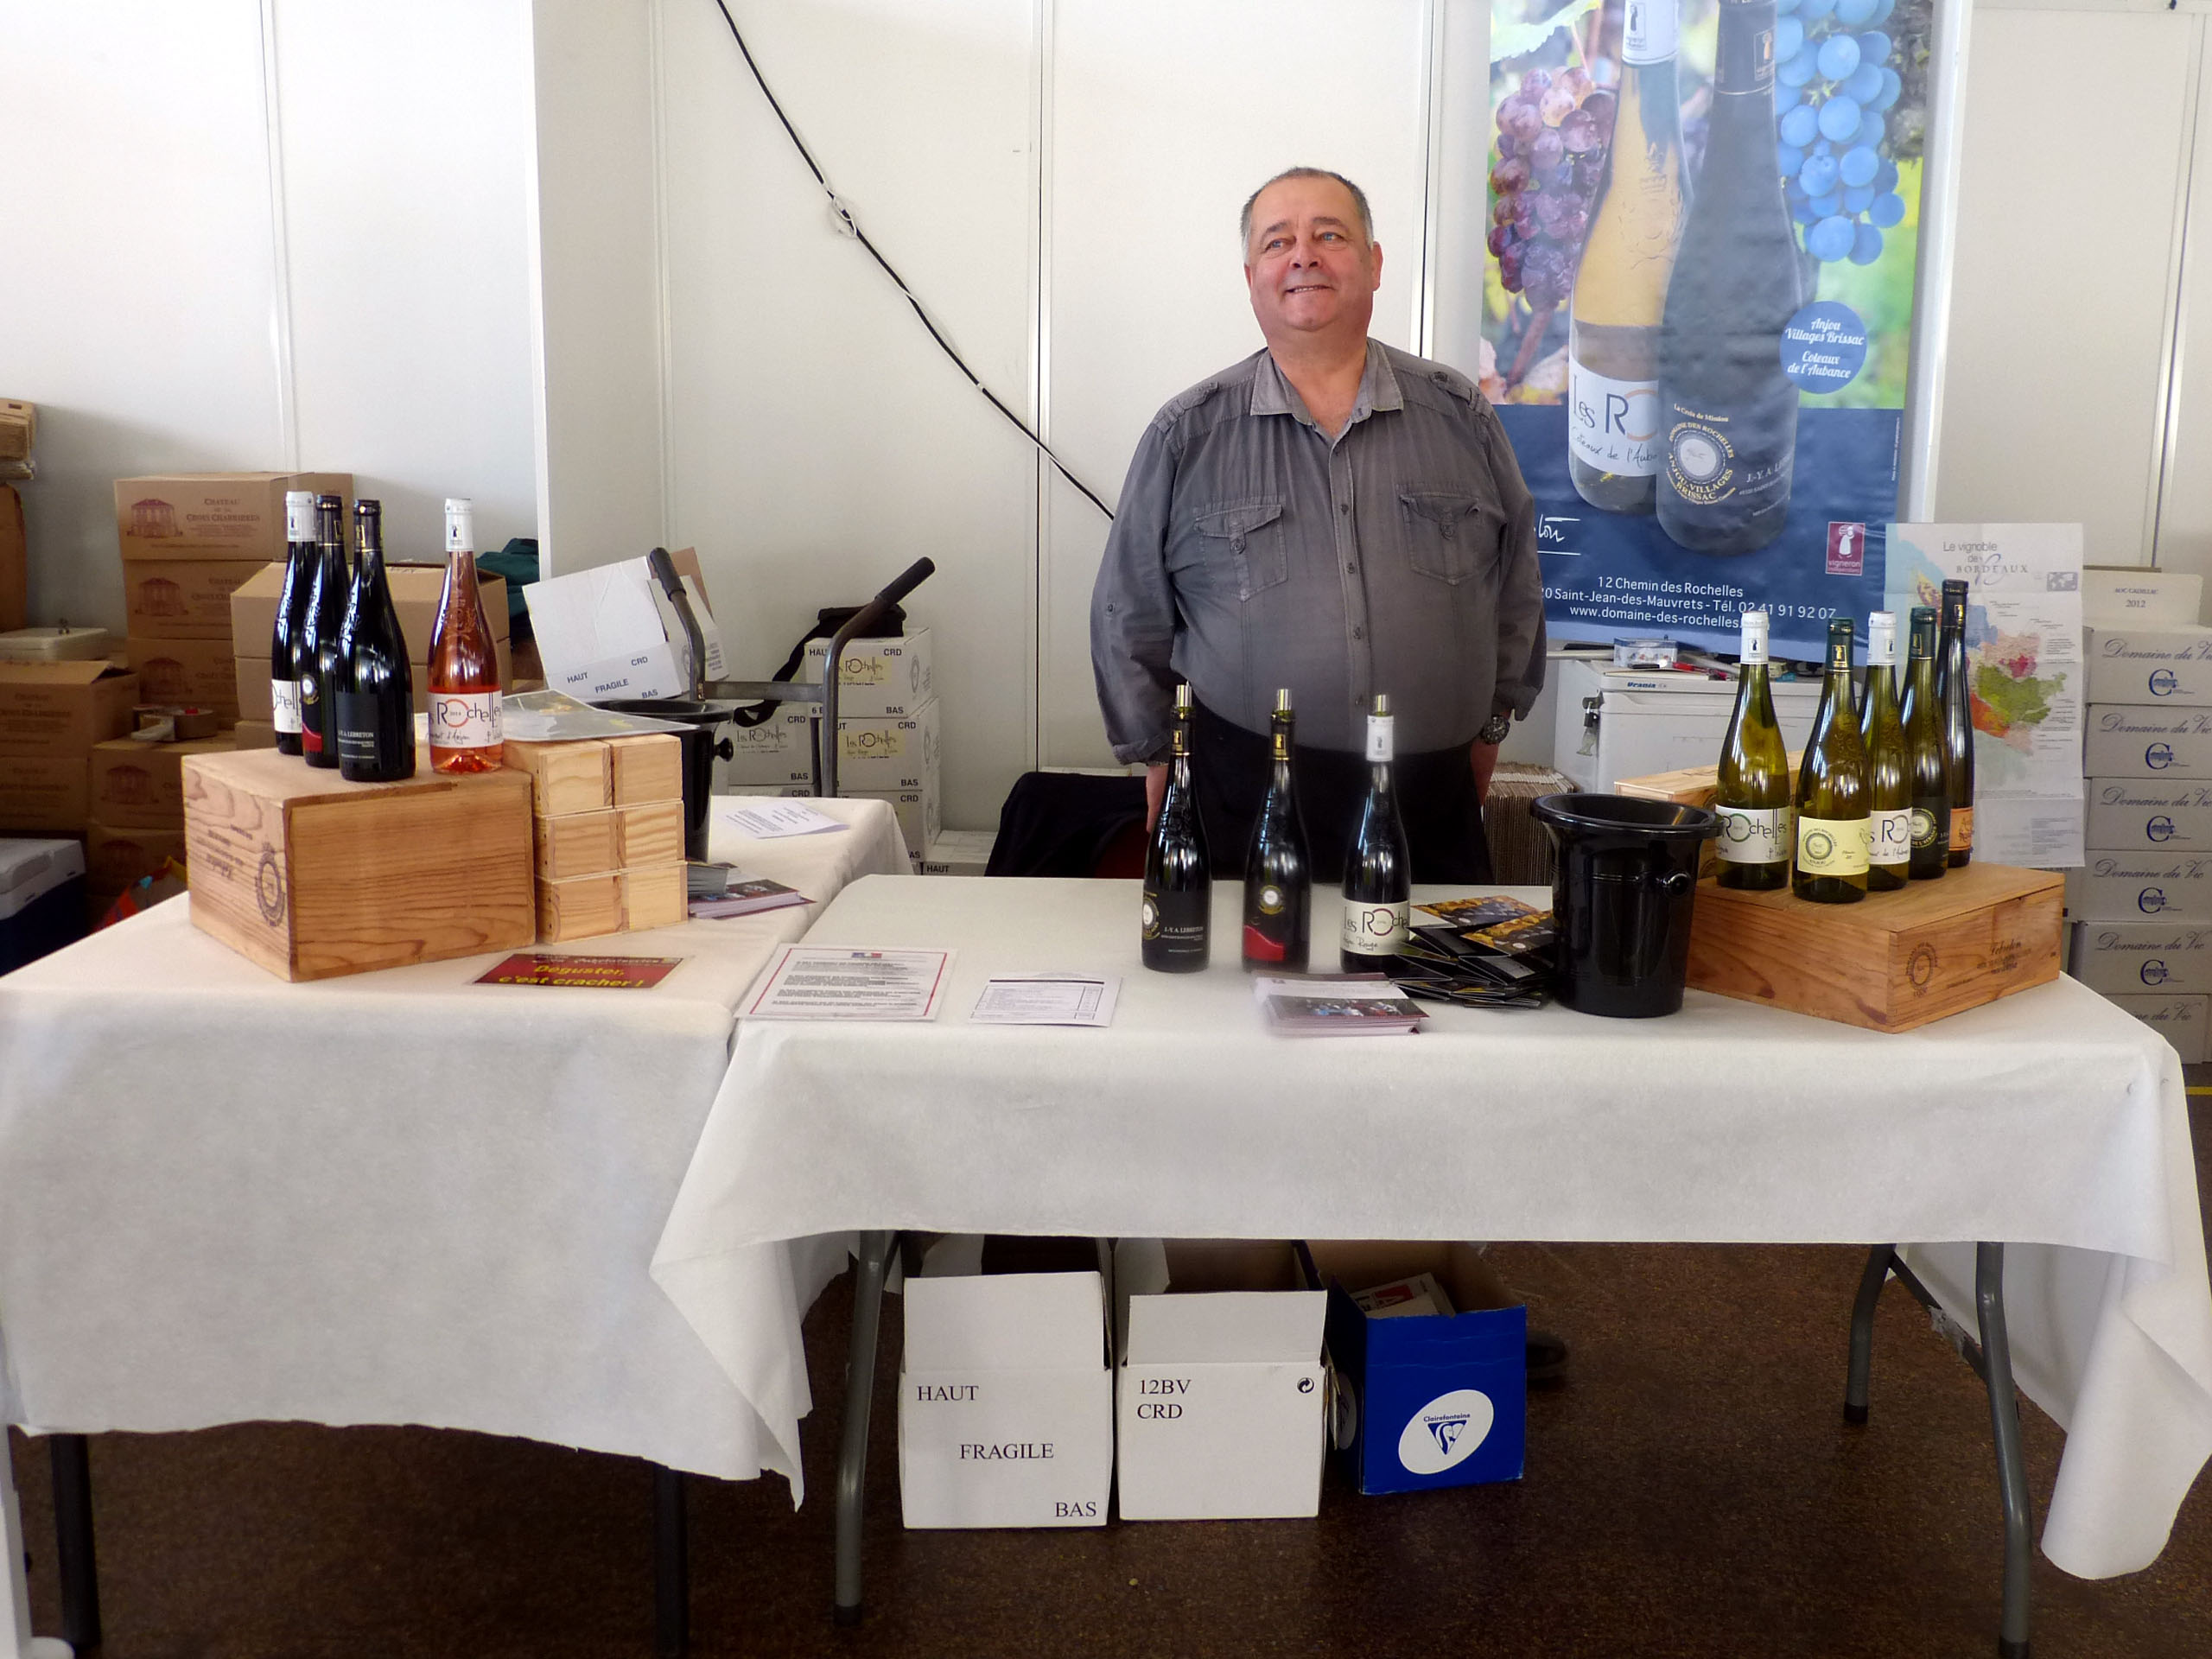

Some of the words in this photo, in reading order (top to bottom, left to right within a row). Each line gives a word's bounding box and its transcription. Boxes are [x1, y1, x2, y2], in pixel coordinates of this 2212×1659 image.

[1811, 318, 1841, 333] Anjou
[1785, 327, 1825, 345] Villages
[1827, 331, 1865, 346] Brissac
[1802, 350, 1840, 365] Coteaux
[1787, 363, 1801, 373] de
[1573, 373, 1595, 429] Les
[1676, 483, 1717, 501] BRISSAC
[1943, 542, 1955, 551] Le
[1959, 542, 1997, 553] vignoble
[1956, 565, 2028, 574] BORDEAUX
[1615, 577, 1659, 591] Chemin
[1661, 581, 1682, 593] des
[1684, 582, 1744, 597] Rochelles
[1554, 588, 1703, 610] Saint-Jean-des-Mauvrets
[2126, 600, 2146, 608] 2012
[883, 648, 902, 657] CRD
[2101, 639, 2172, 659] Domaine
[2174, 646, 2192, 660] du
[631, 656, 648, 667] CRD
[567, 671, 588, 683] HAUT
[594, 678, 629, 694] FRAGILE
[641, 689, 658, 698] BAS
[2100, 713, 2168, 733] Domaine
[2171, 720, 2188, 733] du
[2100, 786, 2169, 806] Domaine
[2171, 793, 2190, 807] du
[926, 865, 949, 874] HAUT
[2093, 858, 2159, 879] Domaine
[2163, 866, 2181, 879] du
[2094, 931, 2160, 950] Domaine
[2164, 938, 2182, 950] du
[917, 1385, 979, 1401] HAUT
[1140, 1379, 1192, 1395] 12BV
[1137, 1403, 1183, 1419] CRD
[1423, 1412, 1471, 1423] Clairefontaine
[960, 1443, 1054, 1459] FRAGILE
[1054, 1502, 1097, 1517] BAS
